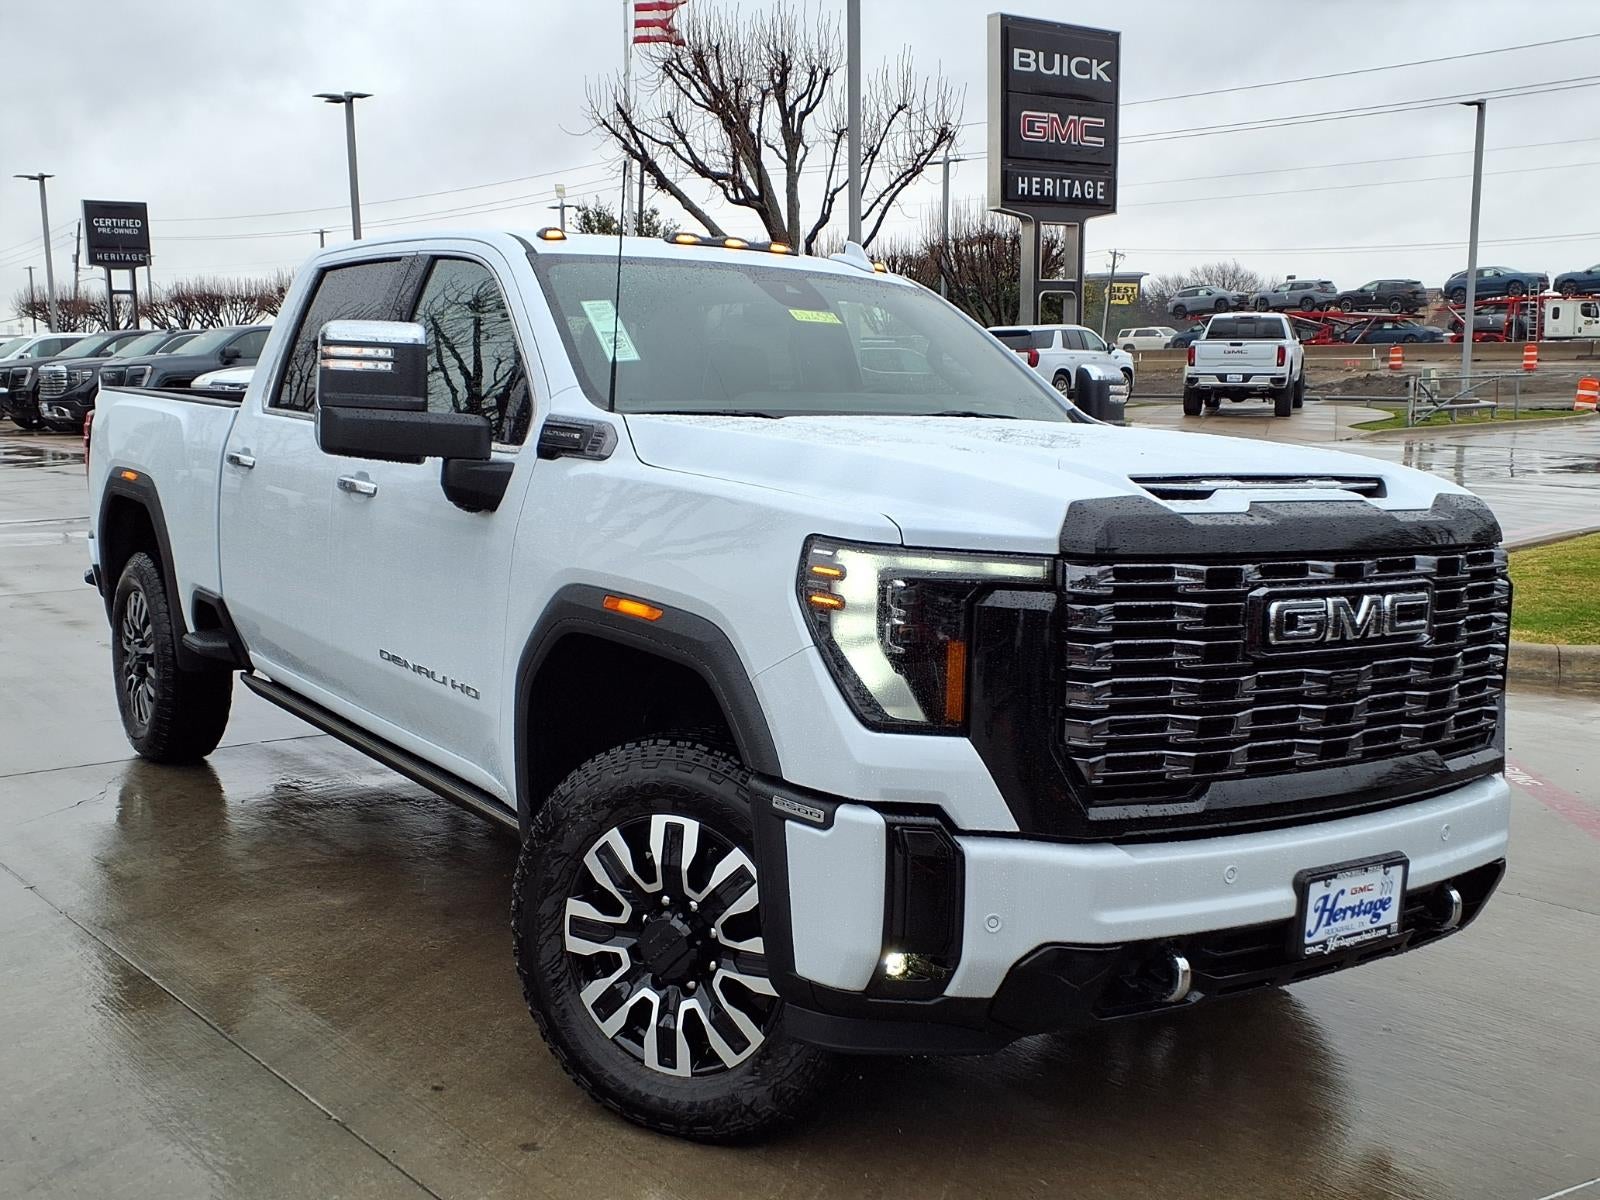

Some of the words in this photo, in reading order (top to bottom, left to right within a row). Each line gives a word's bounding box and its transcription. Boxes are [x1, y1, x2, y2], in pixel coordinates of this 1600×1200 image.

[1013, 48, 1112, 82] BUICK
[1020, 110, 1105, 147] GMC
[1018, 177, 1105, 199] HERITAGE
[93, 218, 142, 228] CERTIFIED
[97, 227, 139, 235] PRE-OWNED
[96, 253, 144, 262] HERITAGE
[1110, 286, 1136, 294] BEST
[1110, 293, 1133, 303] BUY
[1269, 592, 1429, 645] GMC
[379, 648, 447, 686] DENALI
[451, 678, 480, 700] HD
[1350, 883, 1375, 895] GMC
[1306, 888, 1393, 938] Heritage
